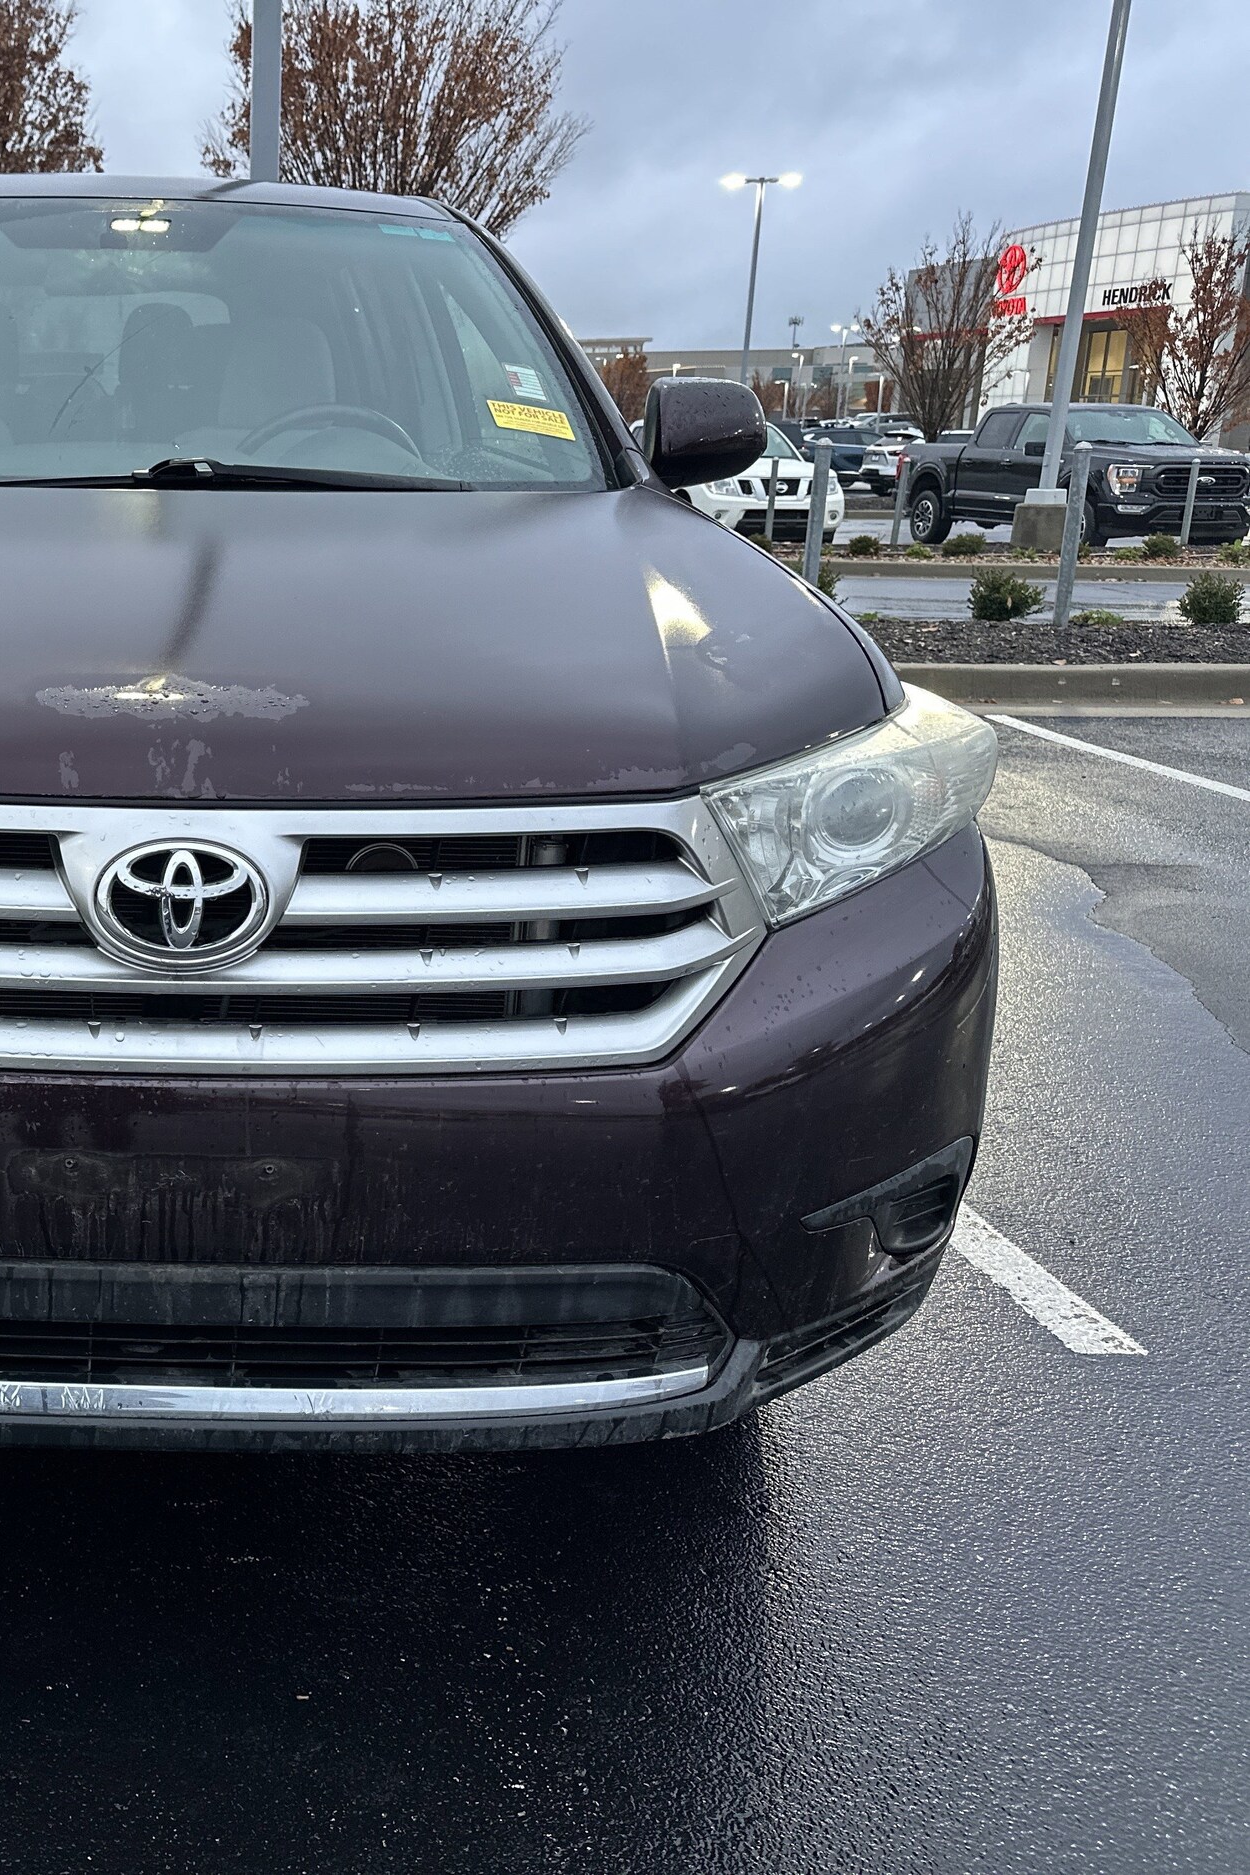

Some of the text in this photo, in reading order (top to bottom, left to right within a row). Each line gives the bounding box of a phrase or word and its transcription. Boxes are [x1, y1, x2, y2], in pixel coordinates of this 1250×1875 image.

[992, 297, 1027, 316] YOTA
[491, 402, 565, 419] THIS VEHICLE
[494, 407, 515, 415] NOT
[519, 411, 539, 420] FOR
[541, 414, 566, 425] SALE
